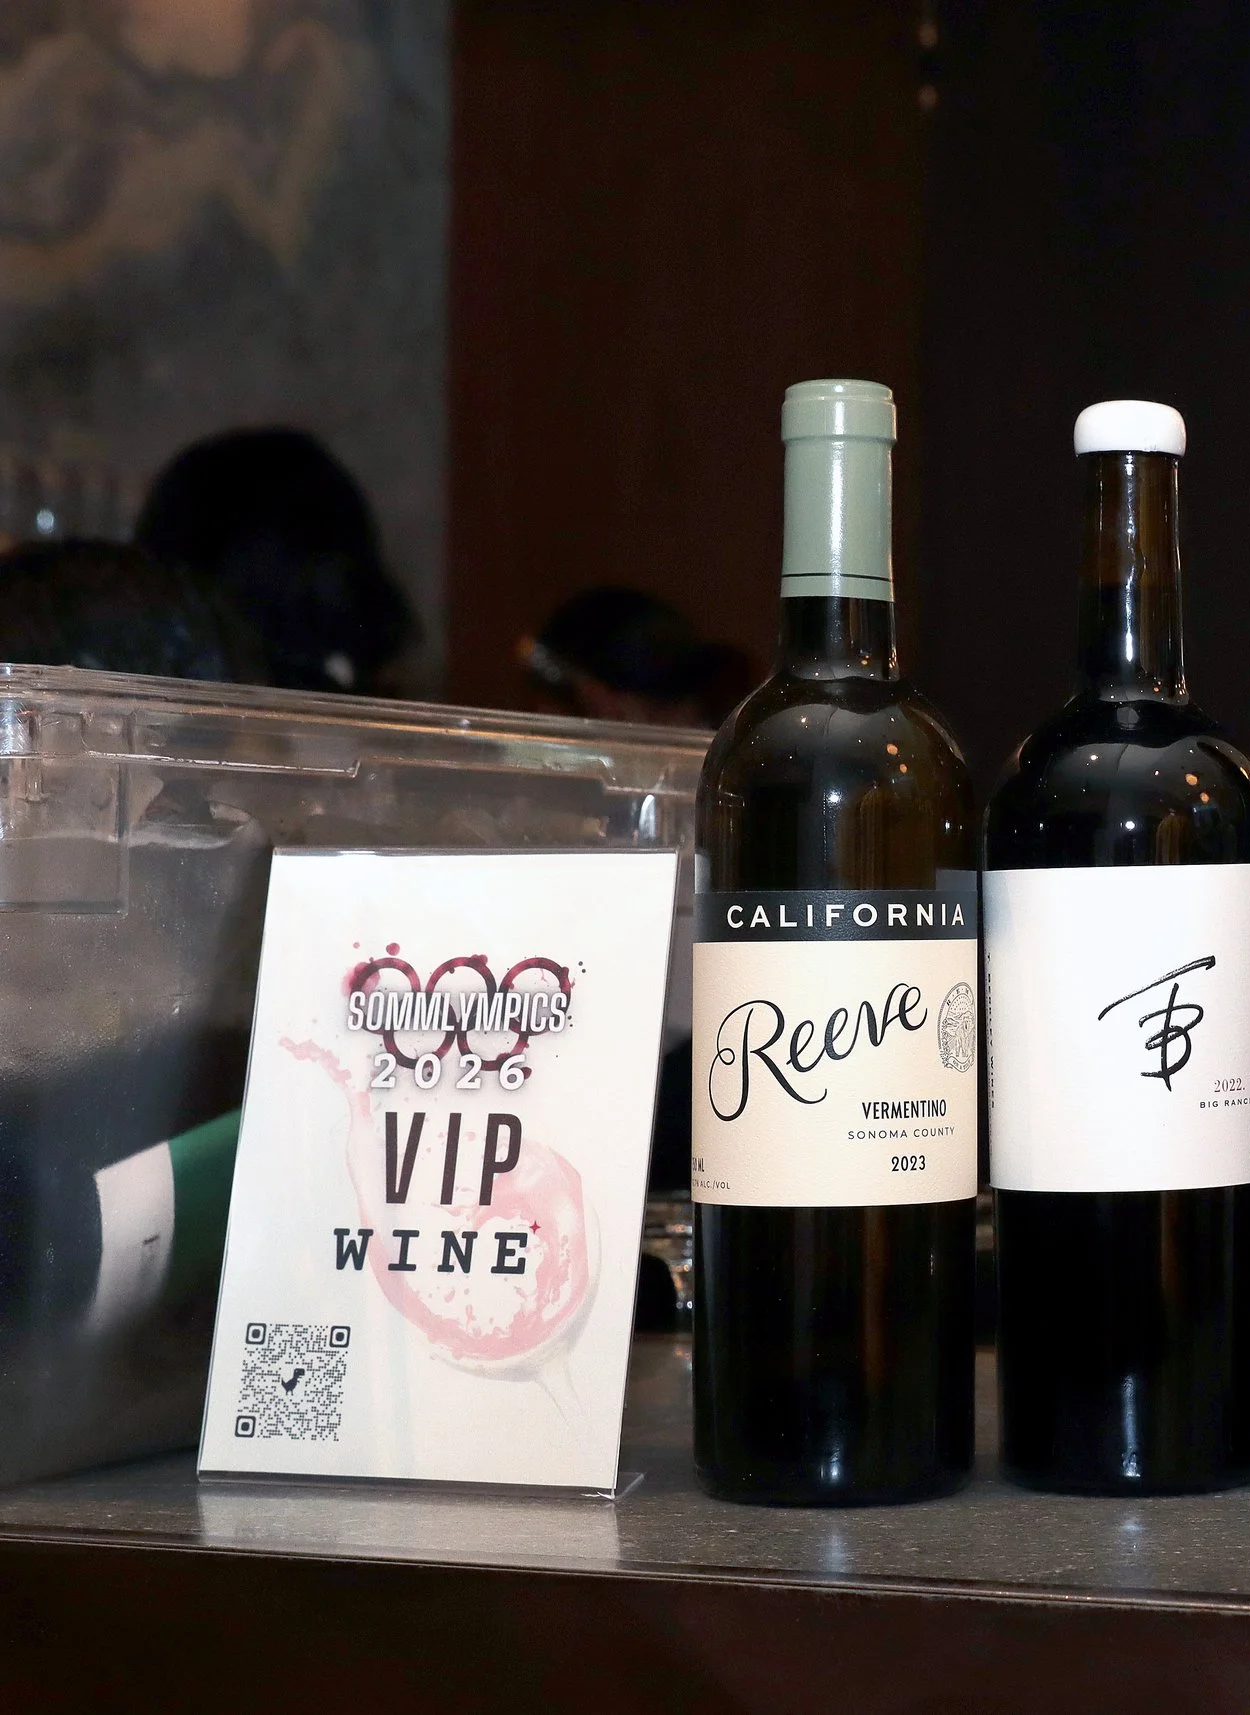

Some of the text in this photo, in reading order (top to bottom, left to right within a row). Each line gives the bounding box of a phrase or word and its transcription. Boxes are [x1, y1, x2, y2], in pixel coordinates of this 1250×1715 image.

[726, 902, 966, 930] CALIFORNIA
[347, 990, 568, 1034] SOMMLYMPICS
[708, 982, 928, 1122] Reeve
[371, 1052, 526, 1091] 2026
[1213, 1076, 1246, 1094] 2022.
[861, 1099, 948, 1121] VERMENTINO
[1199, 1100, 1221, 1109] BIG
[847, 1126, 956, 1141] SONOMA COUNTY
[384, 1110, 523, 1206] VIP
[890, 1154, 927, 1173] 2023
[334, 1227, 528, 1275] WINE
